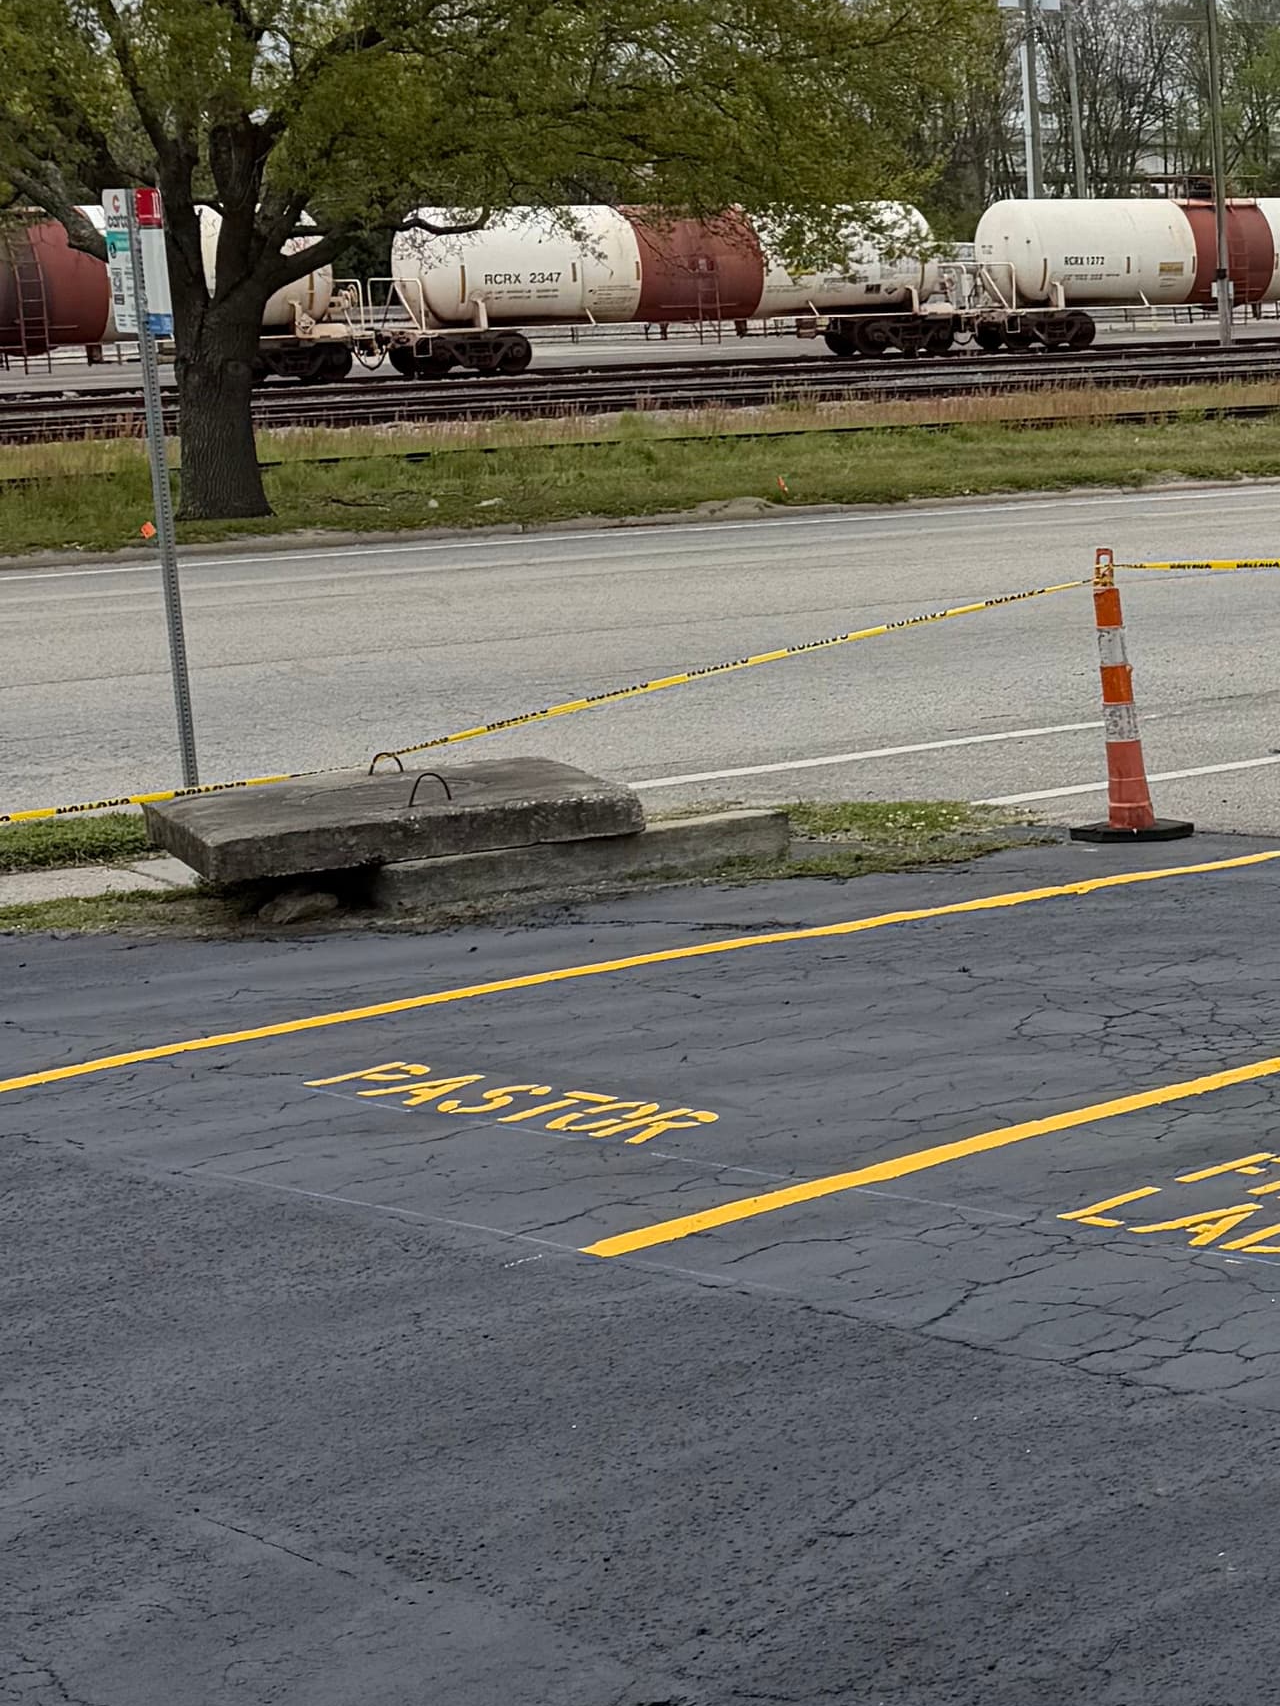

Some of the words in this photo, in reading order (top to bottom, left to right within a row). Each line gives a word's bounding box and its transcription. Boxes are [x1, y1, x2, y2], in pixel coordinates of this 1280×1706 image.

[484, 273, 521, 285] RCRX
[529, 272, 562, 284] 2347
[303, 1061, 719, 1144] PASTOR
